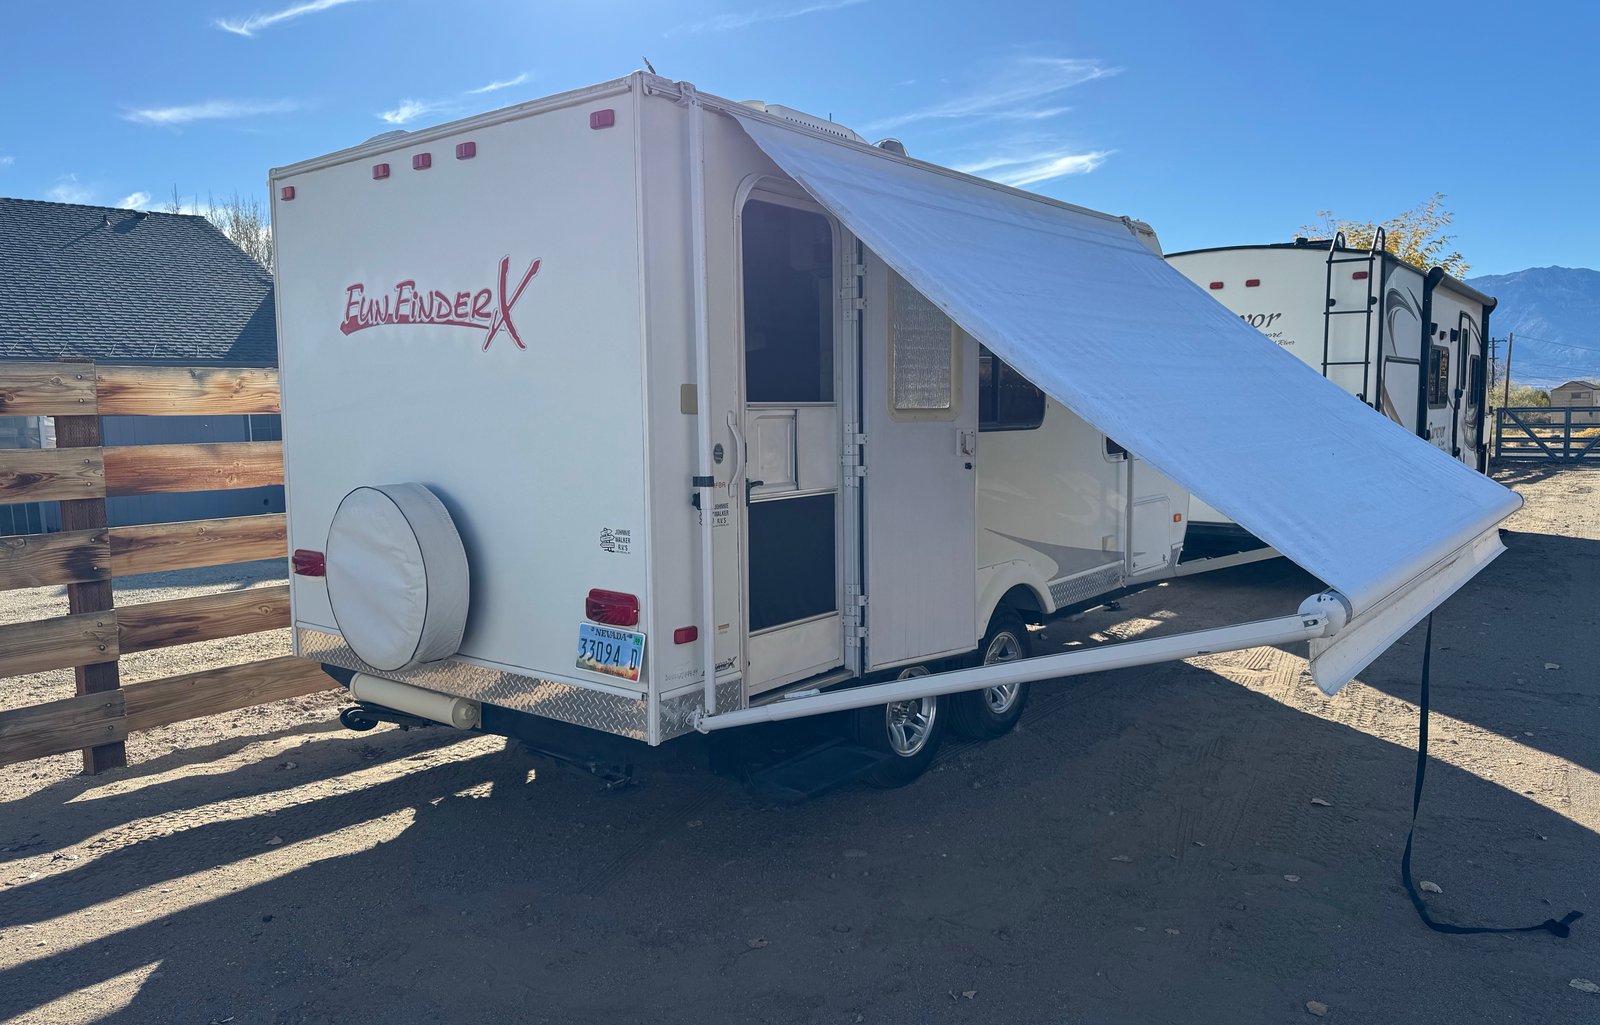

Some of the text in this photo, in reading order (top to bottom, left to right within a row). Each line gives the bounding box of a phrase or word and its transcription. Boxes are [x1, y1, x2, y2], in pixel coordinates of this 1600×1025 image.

[482, 254, 542, 352] X
[595, 628, 627, 641] NEVADA
[579, 638, 621, 667] 33094
[629, 648, 638, 671] D
